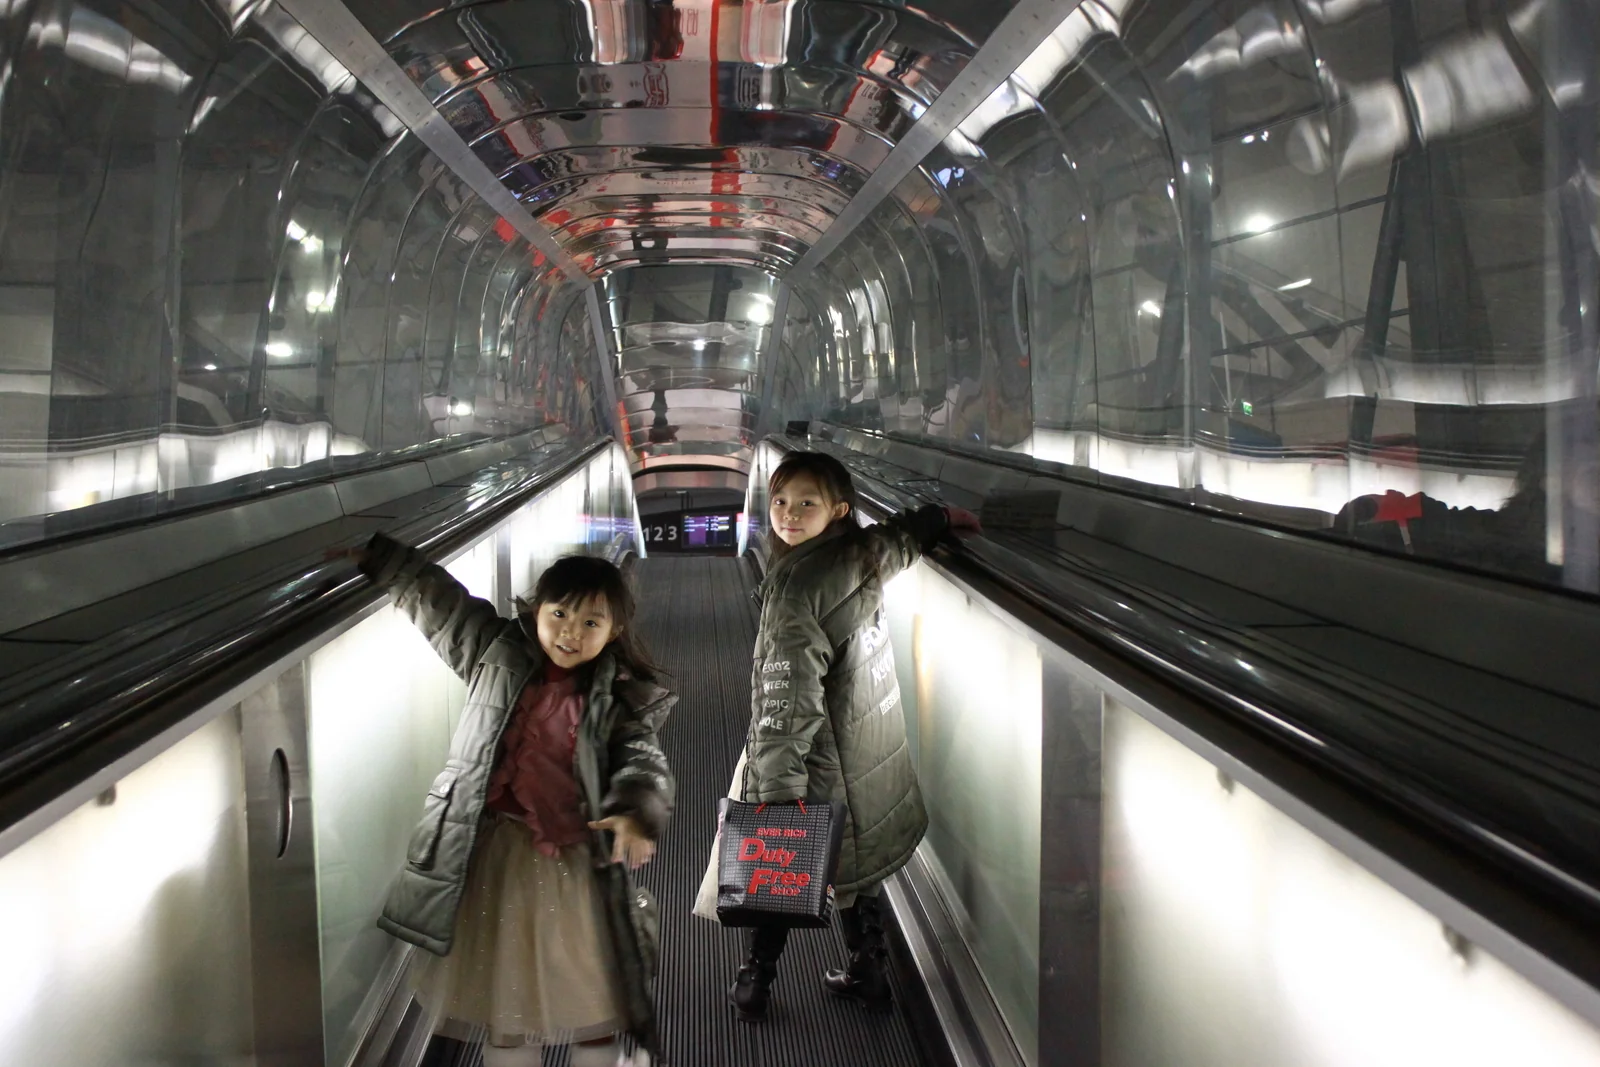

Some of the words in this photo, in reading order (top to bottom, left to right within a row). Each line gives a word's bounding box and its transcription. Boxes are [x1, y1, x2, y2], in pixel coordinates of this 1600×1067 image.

[757, 827, 781, 837] EVER
[782, 828, 808, 838] RICH
[736, 837, 797, 868] Duty
[747, 868, 811, 895] Free
[769, 886, 801, 897] SHOP
